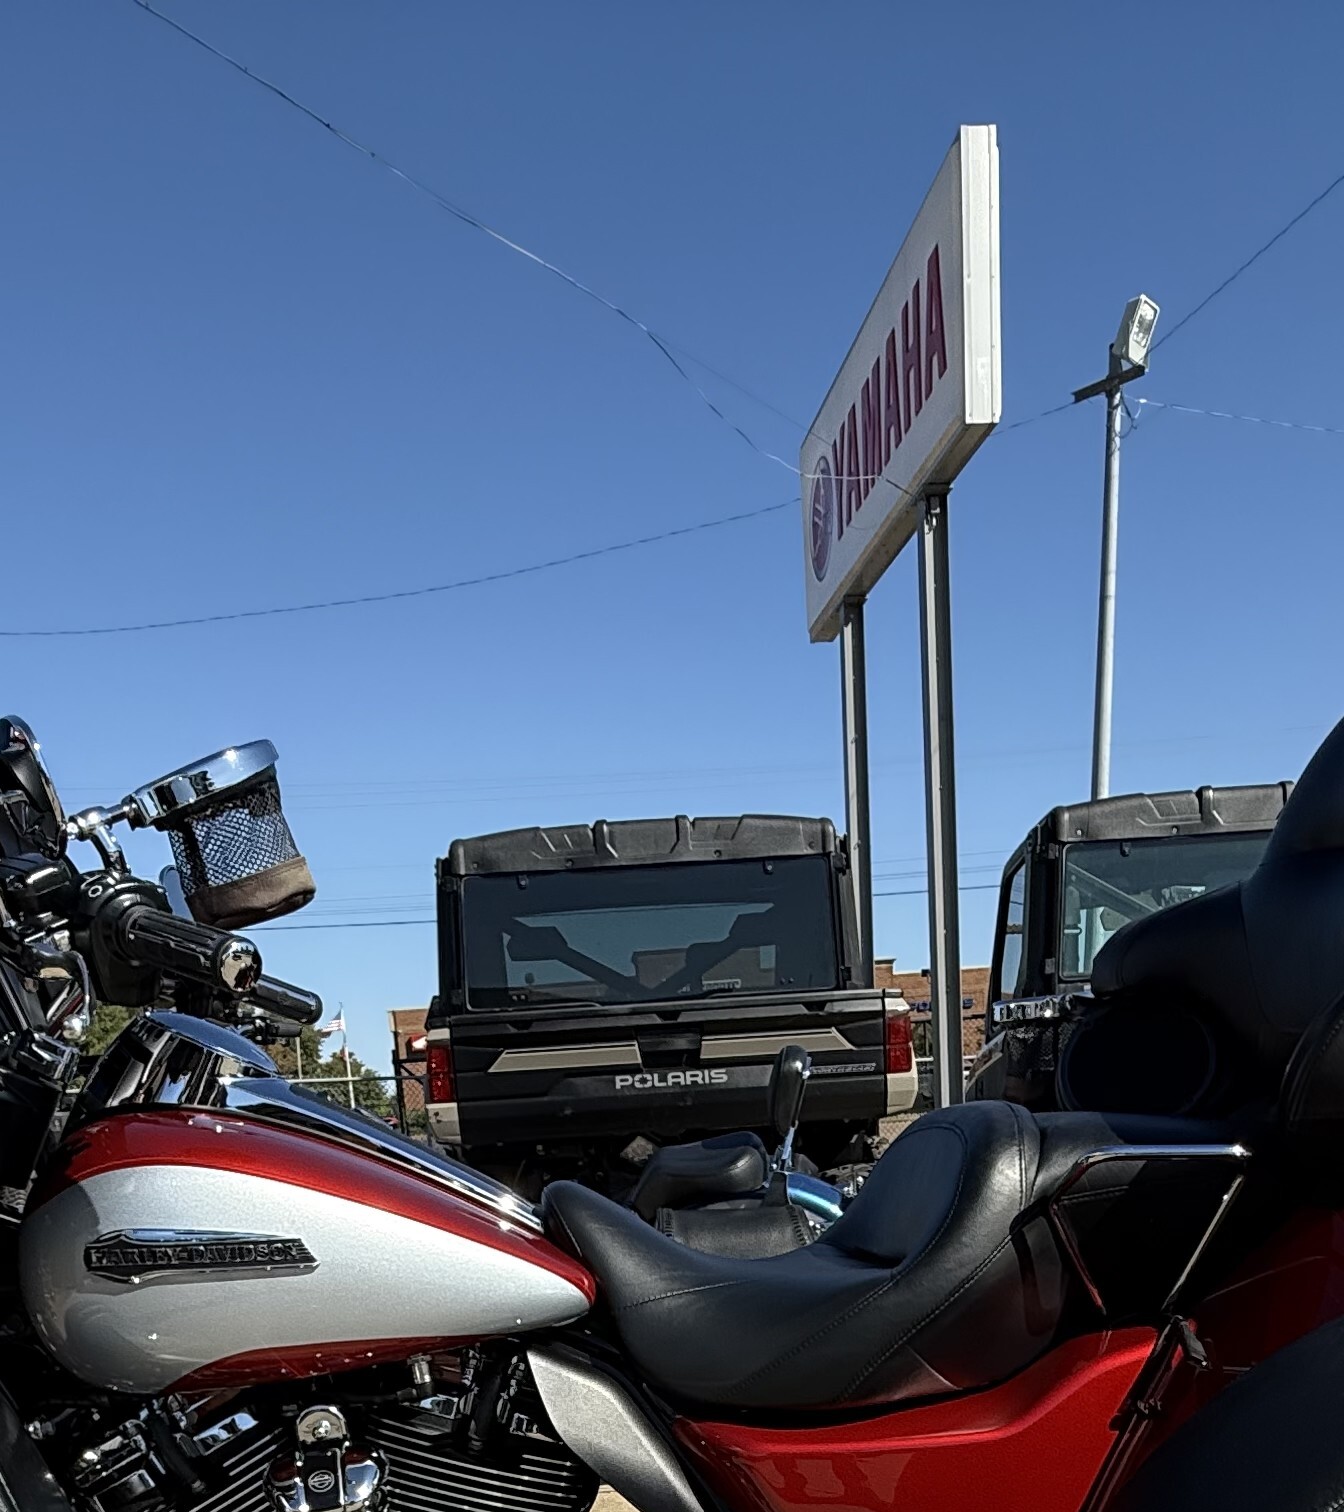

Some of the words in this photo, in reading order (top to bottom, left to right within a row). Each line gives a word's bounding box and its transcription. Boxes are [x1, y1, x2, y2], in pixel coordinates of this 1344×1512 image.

[831, 243, 948, 541] YAMAHA
[615, 1069, 729, 1089] POLARIS
[90, 1242, 303, 1267] HARLEY-DAVIDSON
